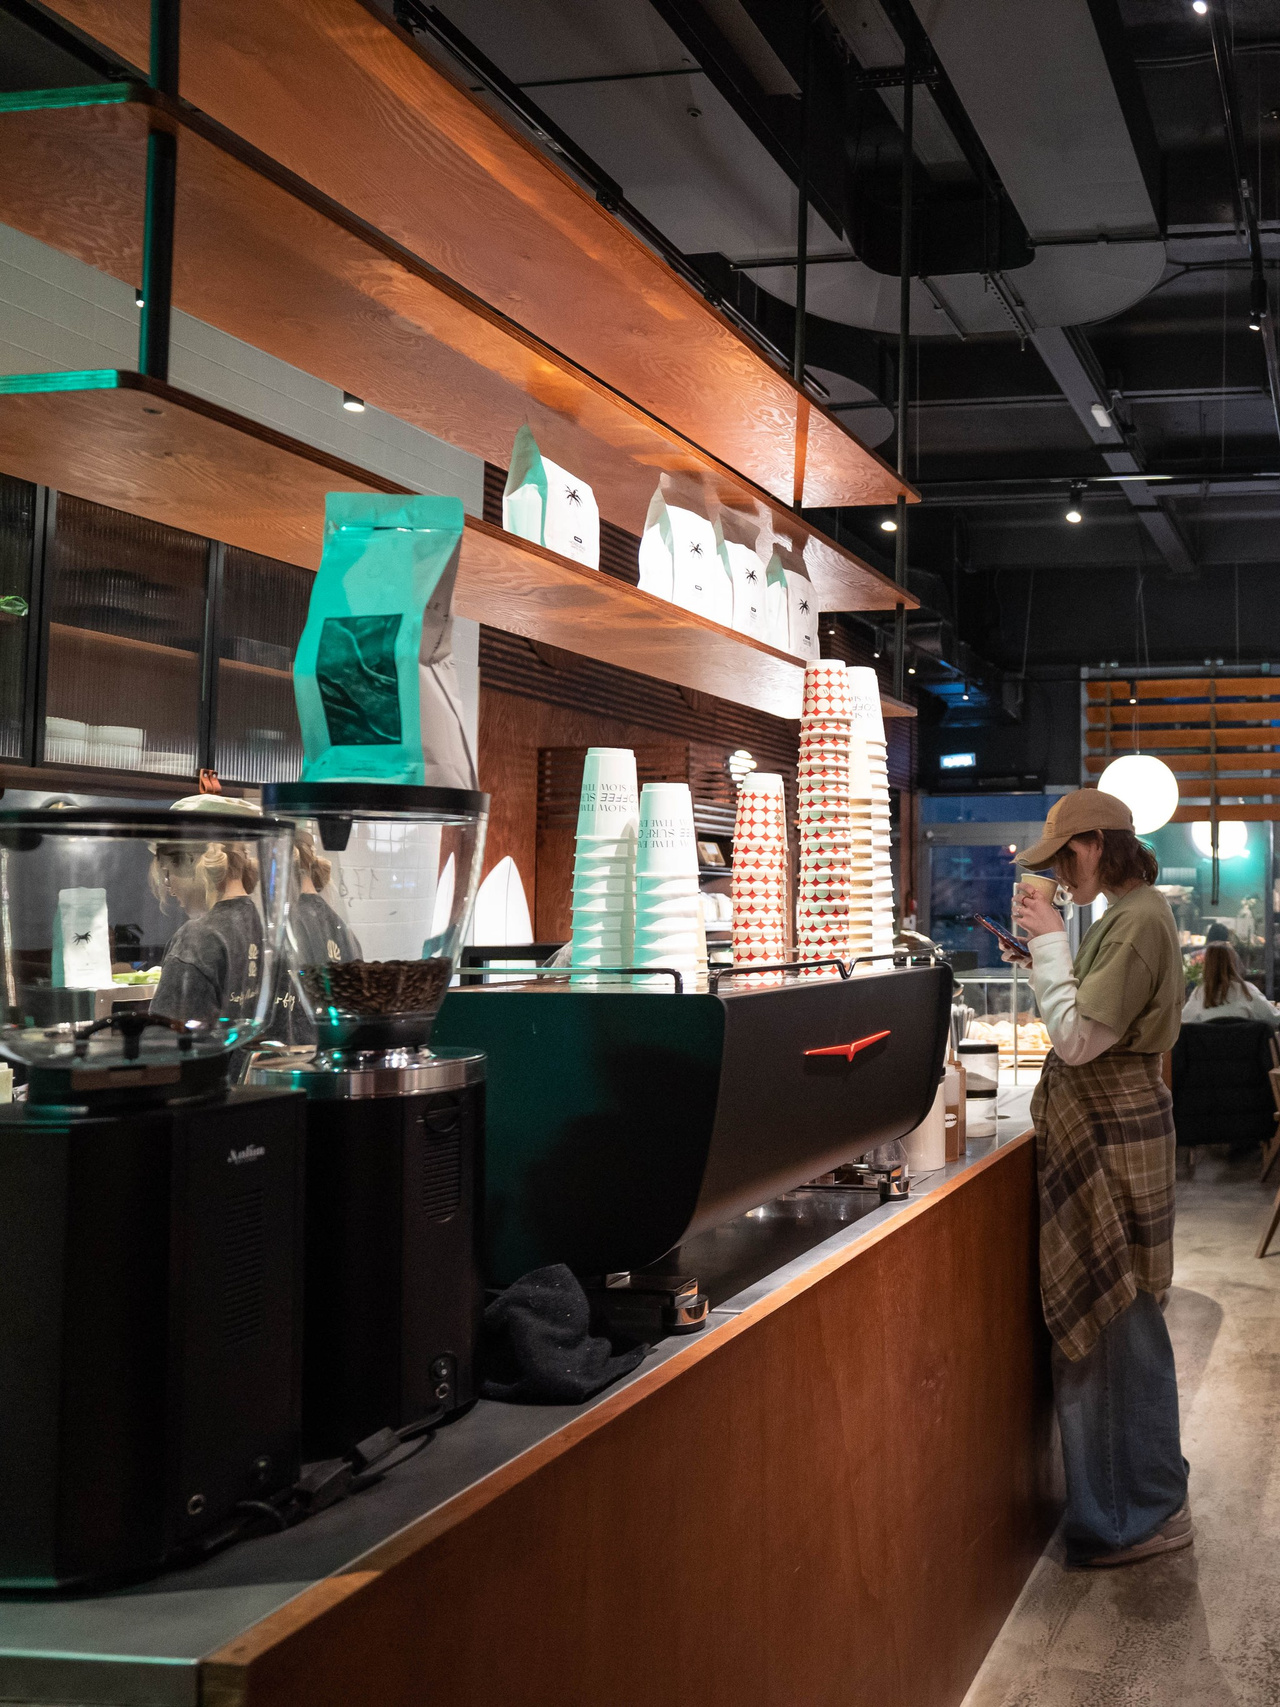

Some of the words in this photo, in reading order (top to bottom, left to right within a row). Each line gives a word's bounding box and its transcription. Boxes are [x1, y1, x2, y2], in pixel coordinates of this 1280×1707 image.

[600, 783, 627, 792] SLOW
[599, 803, 627, 812] SLOW
[646, 828, 675, 838] SURF
